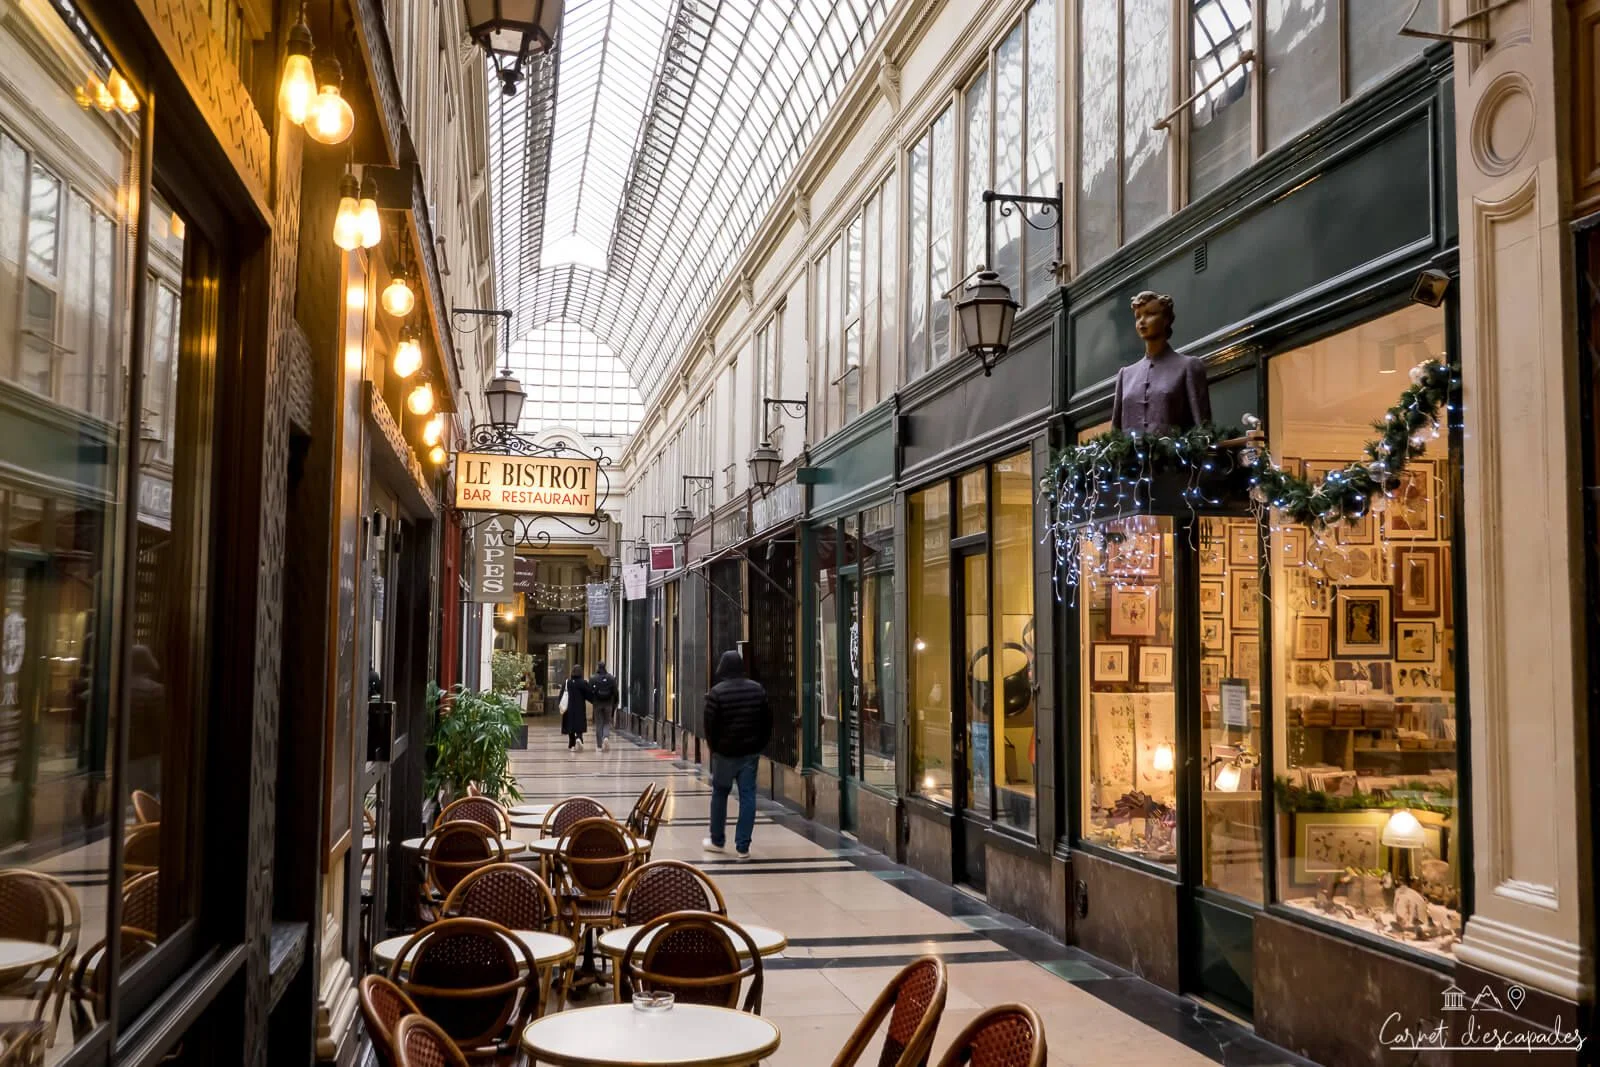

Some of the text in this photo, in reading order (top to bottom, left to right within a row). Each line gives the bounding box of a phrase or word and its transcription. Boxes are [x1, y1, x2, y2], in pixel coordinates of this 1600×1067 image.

[464, 461, 591, 490] LE BISTROT
[463, 488, 590, 506] BAR RESTAURANT
[482, 513, 505, 593] AMPES
